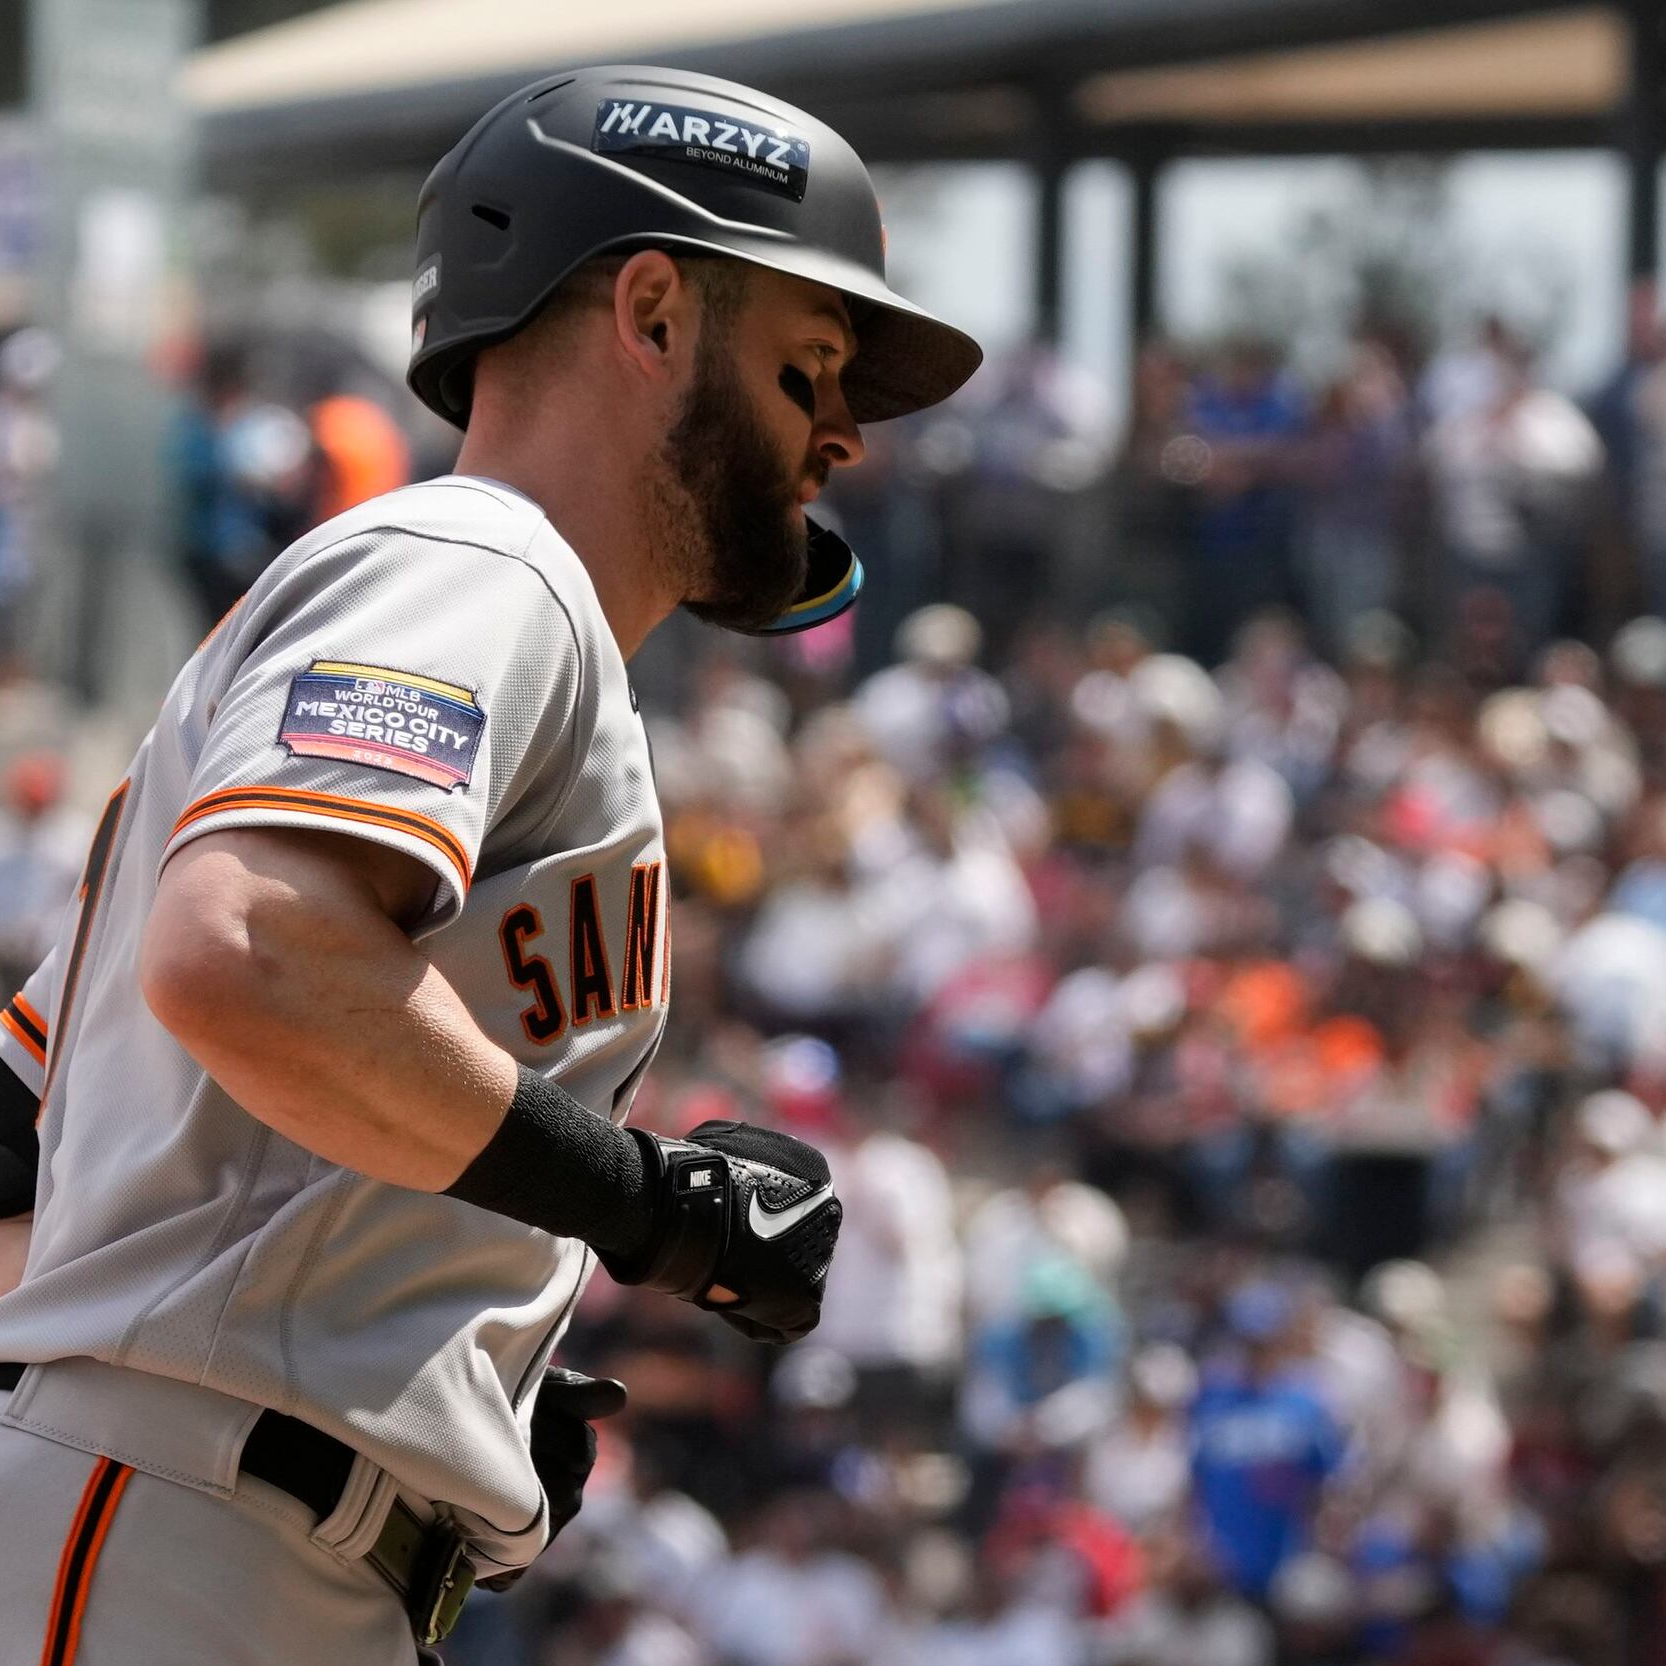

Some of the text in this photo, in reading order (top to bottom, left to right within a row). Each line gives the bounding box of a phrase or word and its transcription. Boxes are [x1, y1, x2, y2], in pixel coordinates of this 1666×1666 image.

[686, 146, 788, 184] BEYOND ALUMINUM
[335, 690, 439, 721] WORLD TOUR
[386, 686, 421, 702] MLB
[295, 701, 469, 750] MEXICO CITY
[328, 720, 430, 753] SERIES
[353, 750, 393, 766] 2023
[498, 862, 662, 1046] SAN
[690, 1170, 711, 1188] NIKE
